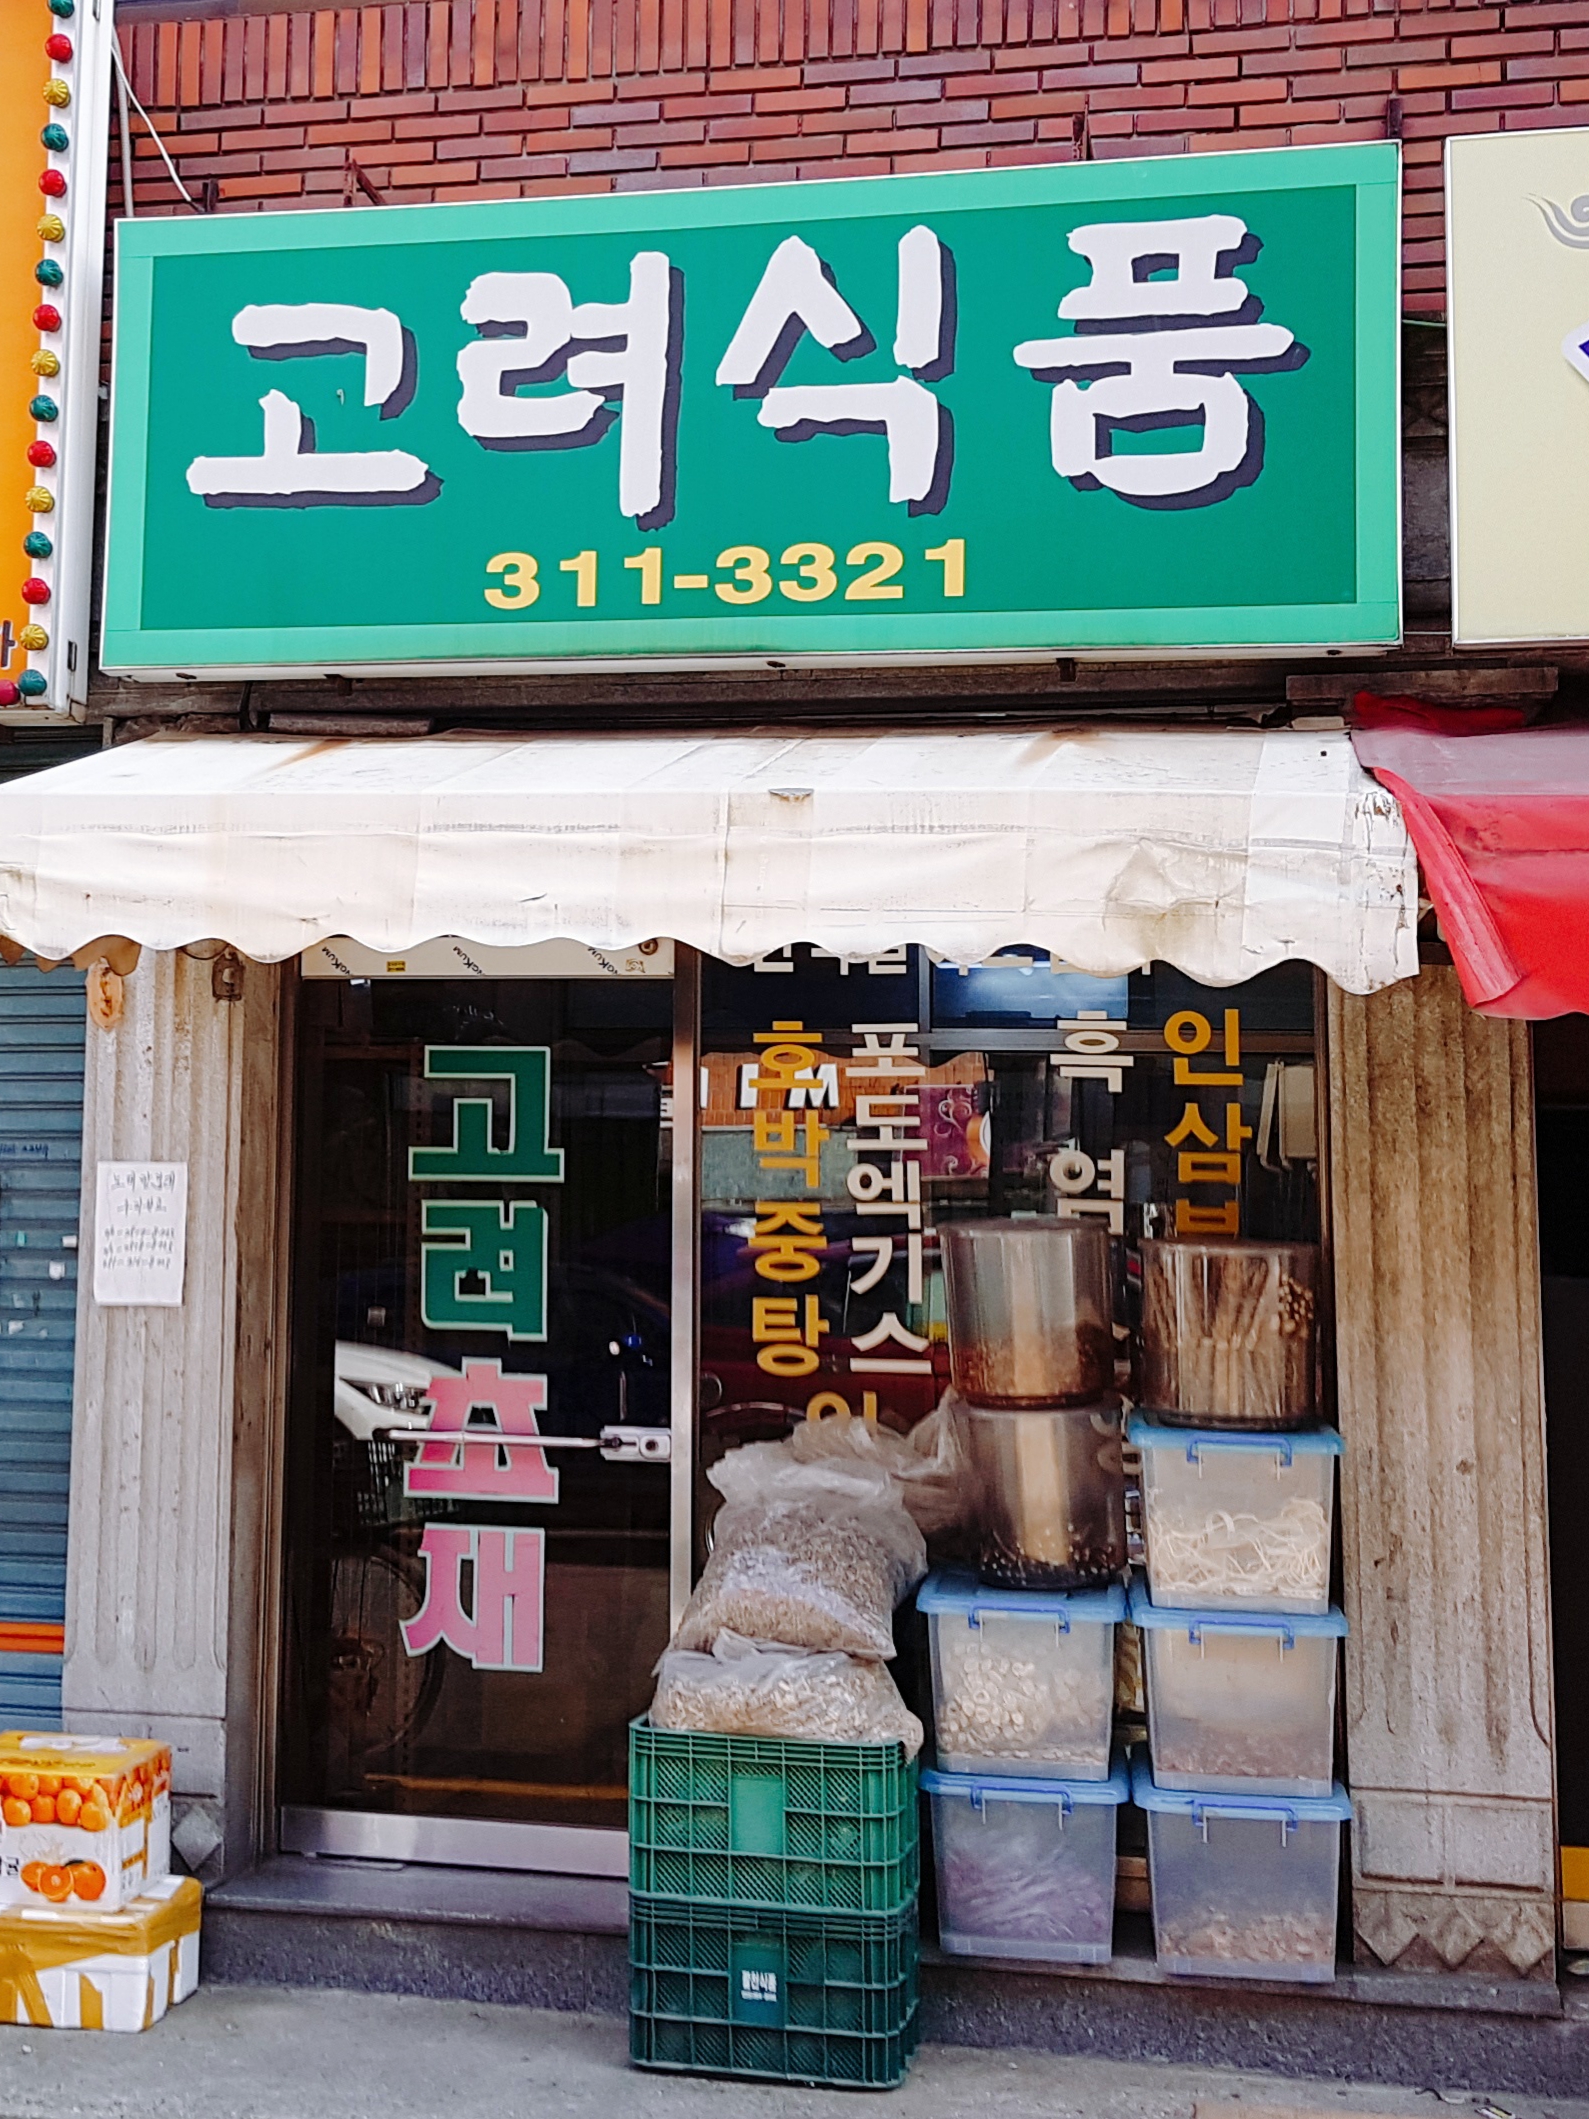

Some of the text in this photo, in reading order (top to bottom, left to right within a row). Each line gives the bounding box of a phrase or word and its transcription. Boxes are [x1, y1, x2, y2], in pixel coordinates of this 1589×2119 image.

[186, 214, 1308, 530] 고려식품
[484, 538, 966, 610] 311-3321
[747, 1020, 829, 1377] 호박중탕
[845, 1022, 932, 1375] 포도엑기스
